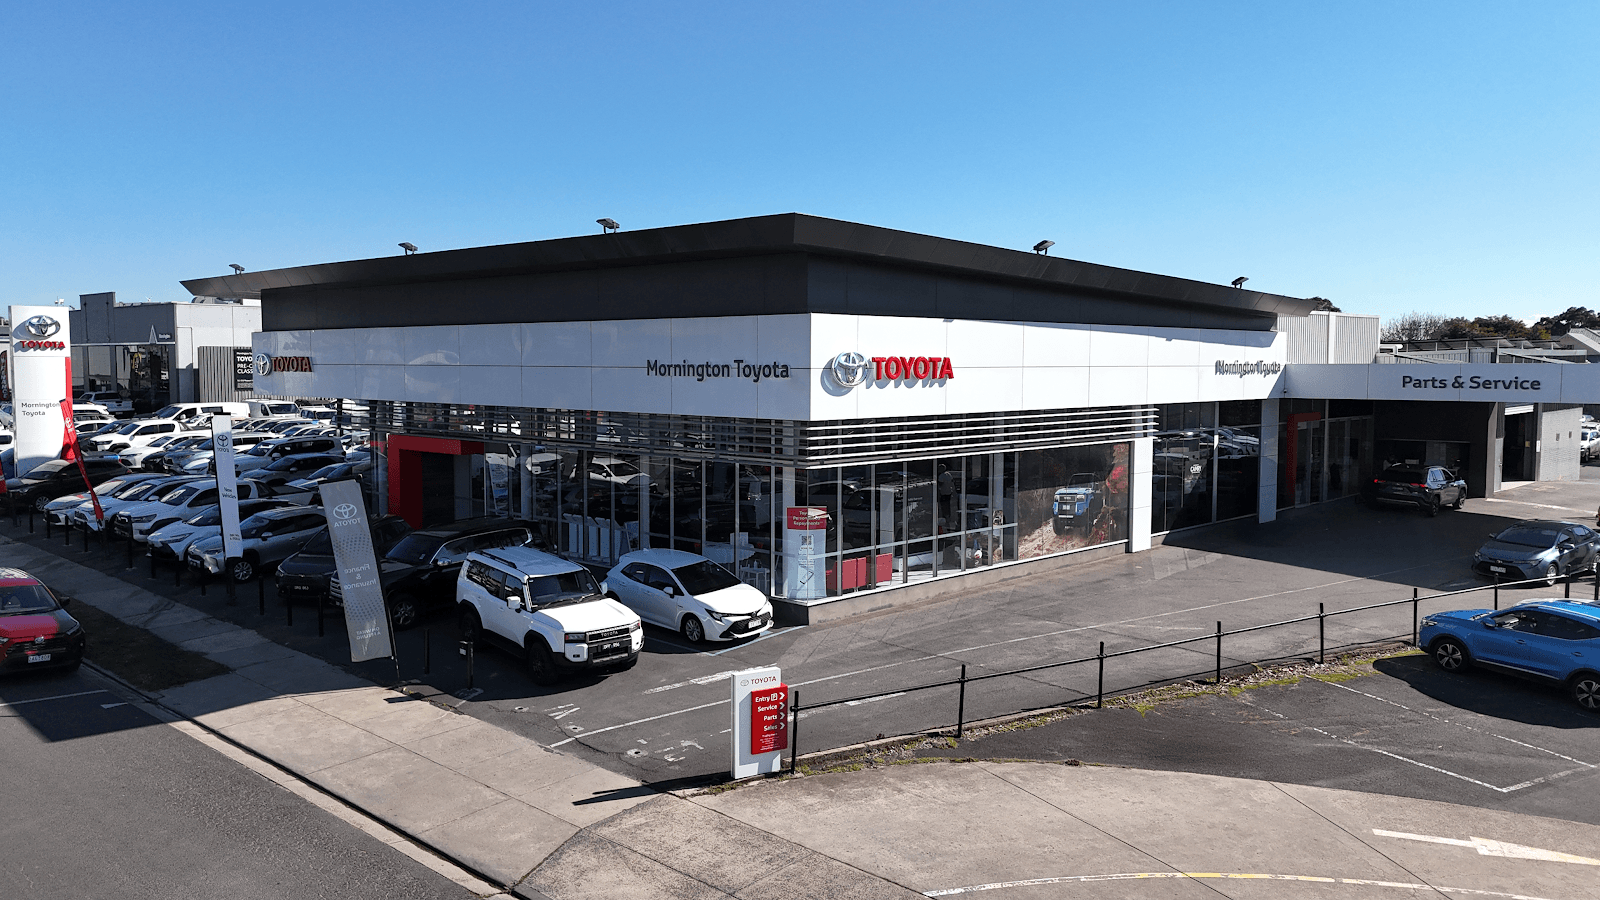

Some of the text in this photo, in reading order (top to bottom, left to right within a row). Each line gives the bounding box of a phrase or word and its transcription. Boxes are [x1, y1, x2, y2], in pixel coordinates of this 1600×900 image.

[20, 340, 66, 349] TOYOTA
[270, 355, 313, 373] TOYOTA
[871, 356, 954, 381] TOYOTA
[1217, 359, 1281, 377] Mornington Toyota
[646, 359, 790, 383] Mornington Toyota
[1401, 374, 1542, 391] Parts & Service
[750, 675, 777, 685] TOYOTA
[755, 695, 770, 703] Entry
[757, 704, 778, 713] Service
[763, 724, 778, 732] Sales
